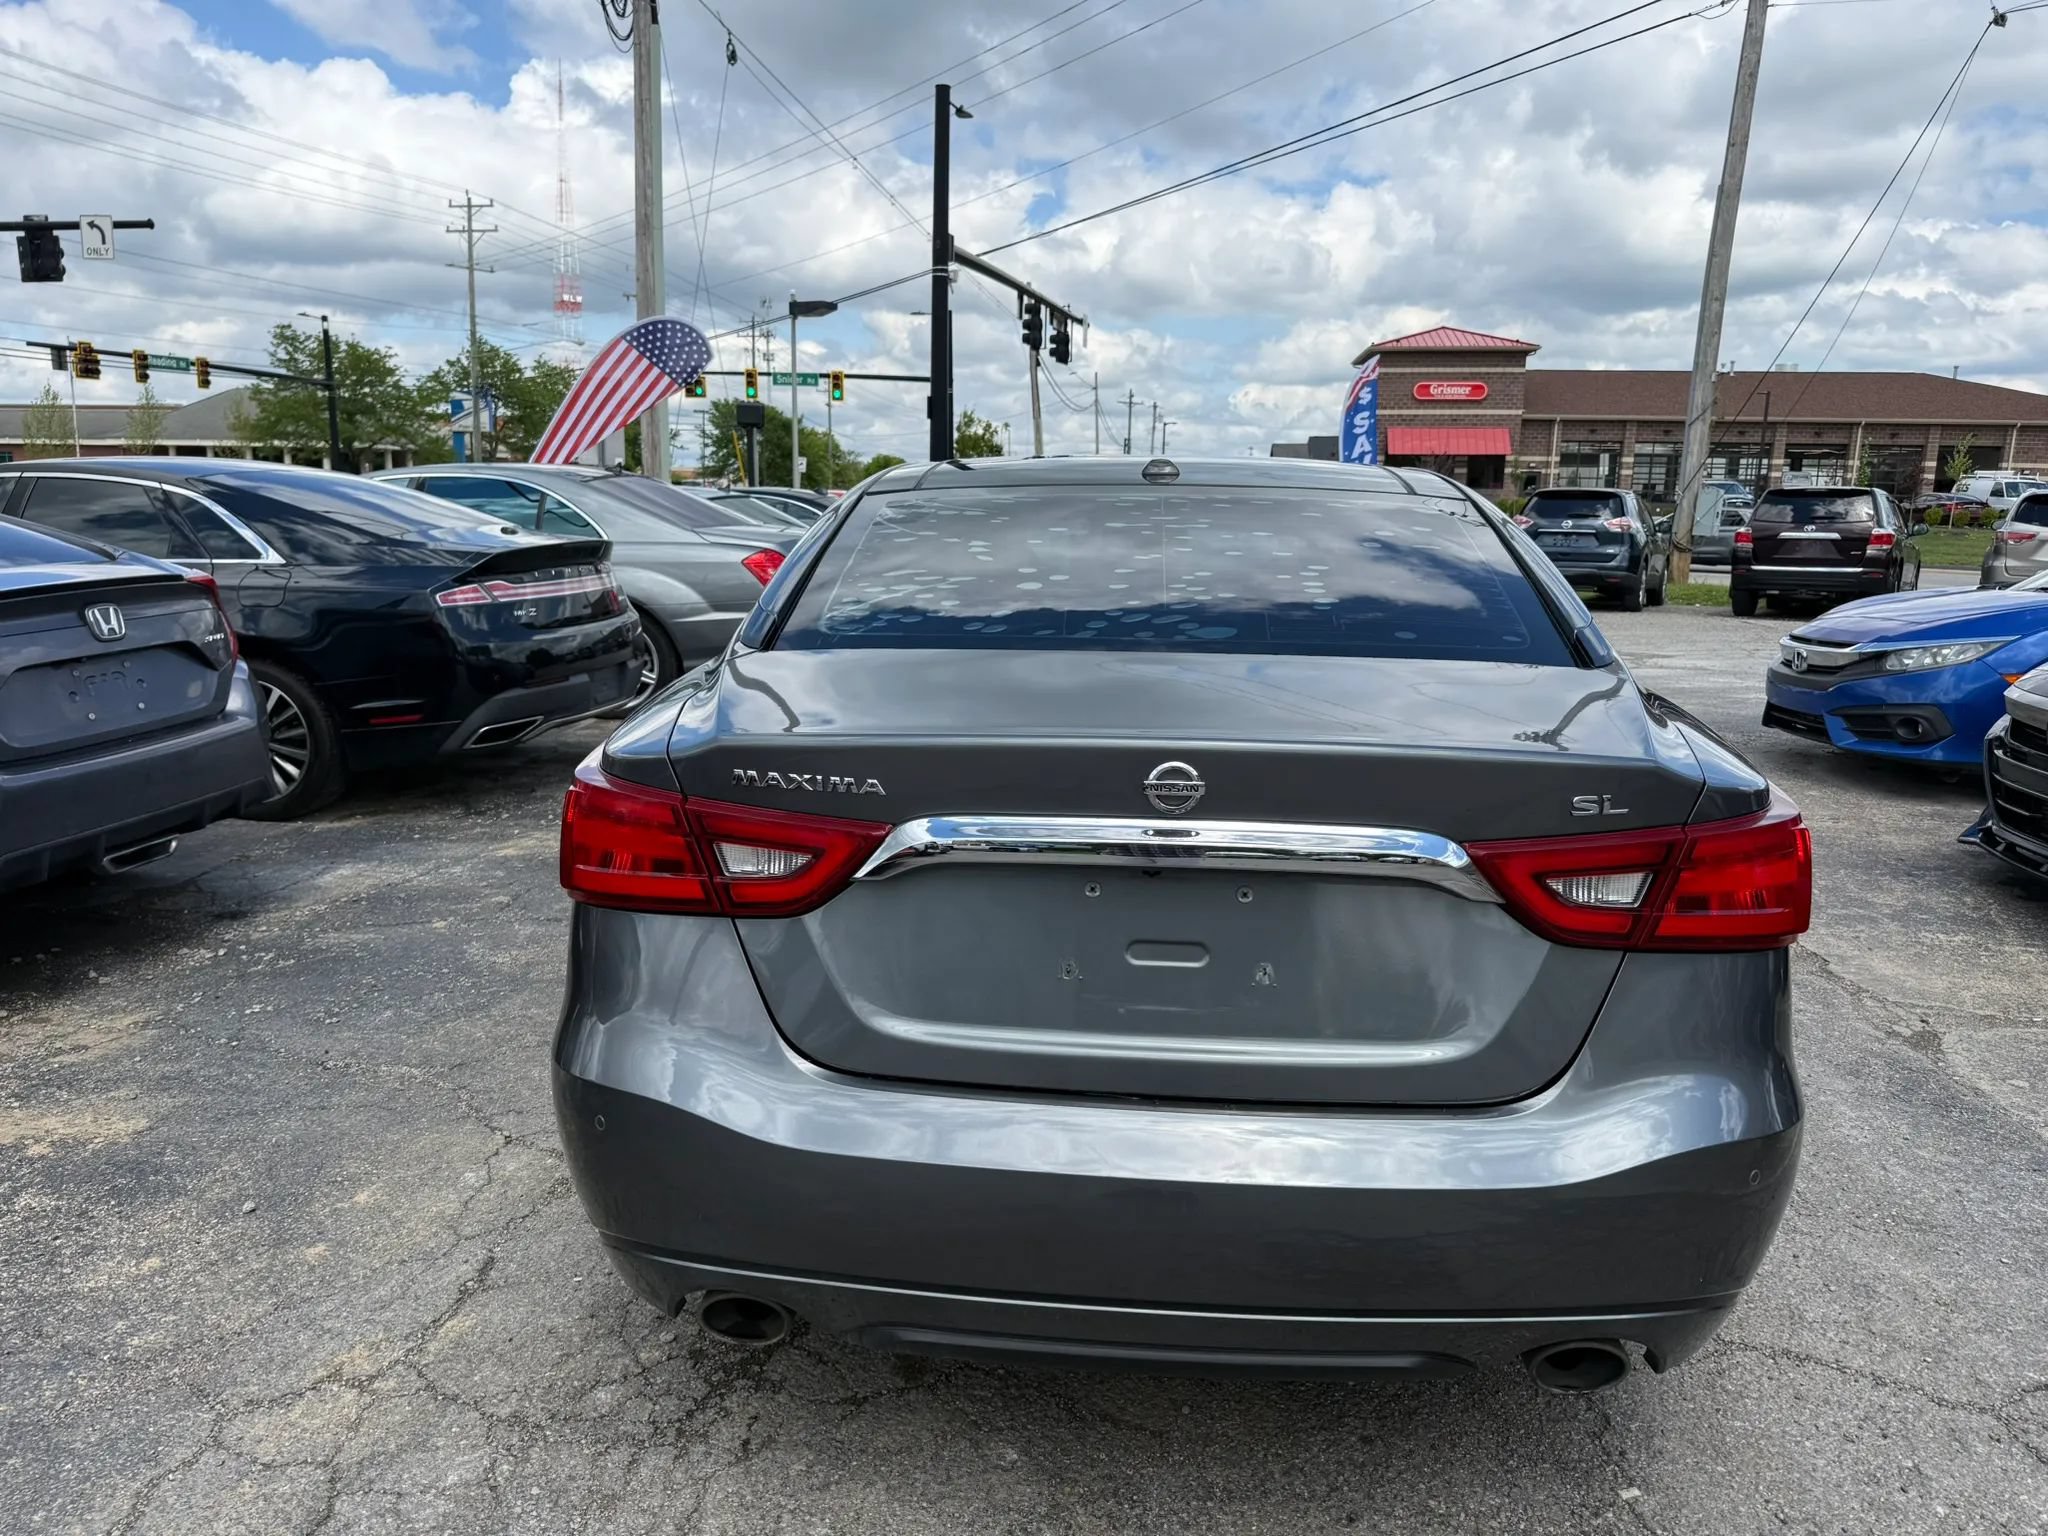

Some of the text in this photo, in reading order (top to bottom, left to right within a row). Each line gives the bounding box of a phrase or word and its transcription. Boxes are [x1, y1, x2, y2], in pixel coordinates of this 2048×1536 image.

[86, 246, 110, 257] ONLY
[562, 293, 582, 303] WLW
[1429, 383, 1472, 395] Grismer
[731, 768, 887, 796] MAXIMA
[1149, 783, 1200, 793] NISSAN
[1570, 794, 1629, 816] SL
